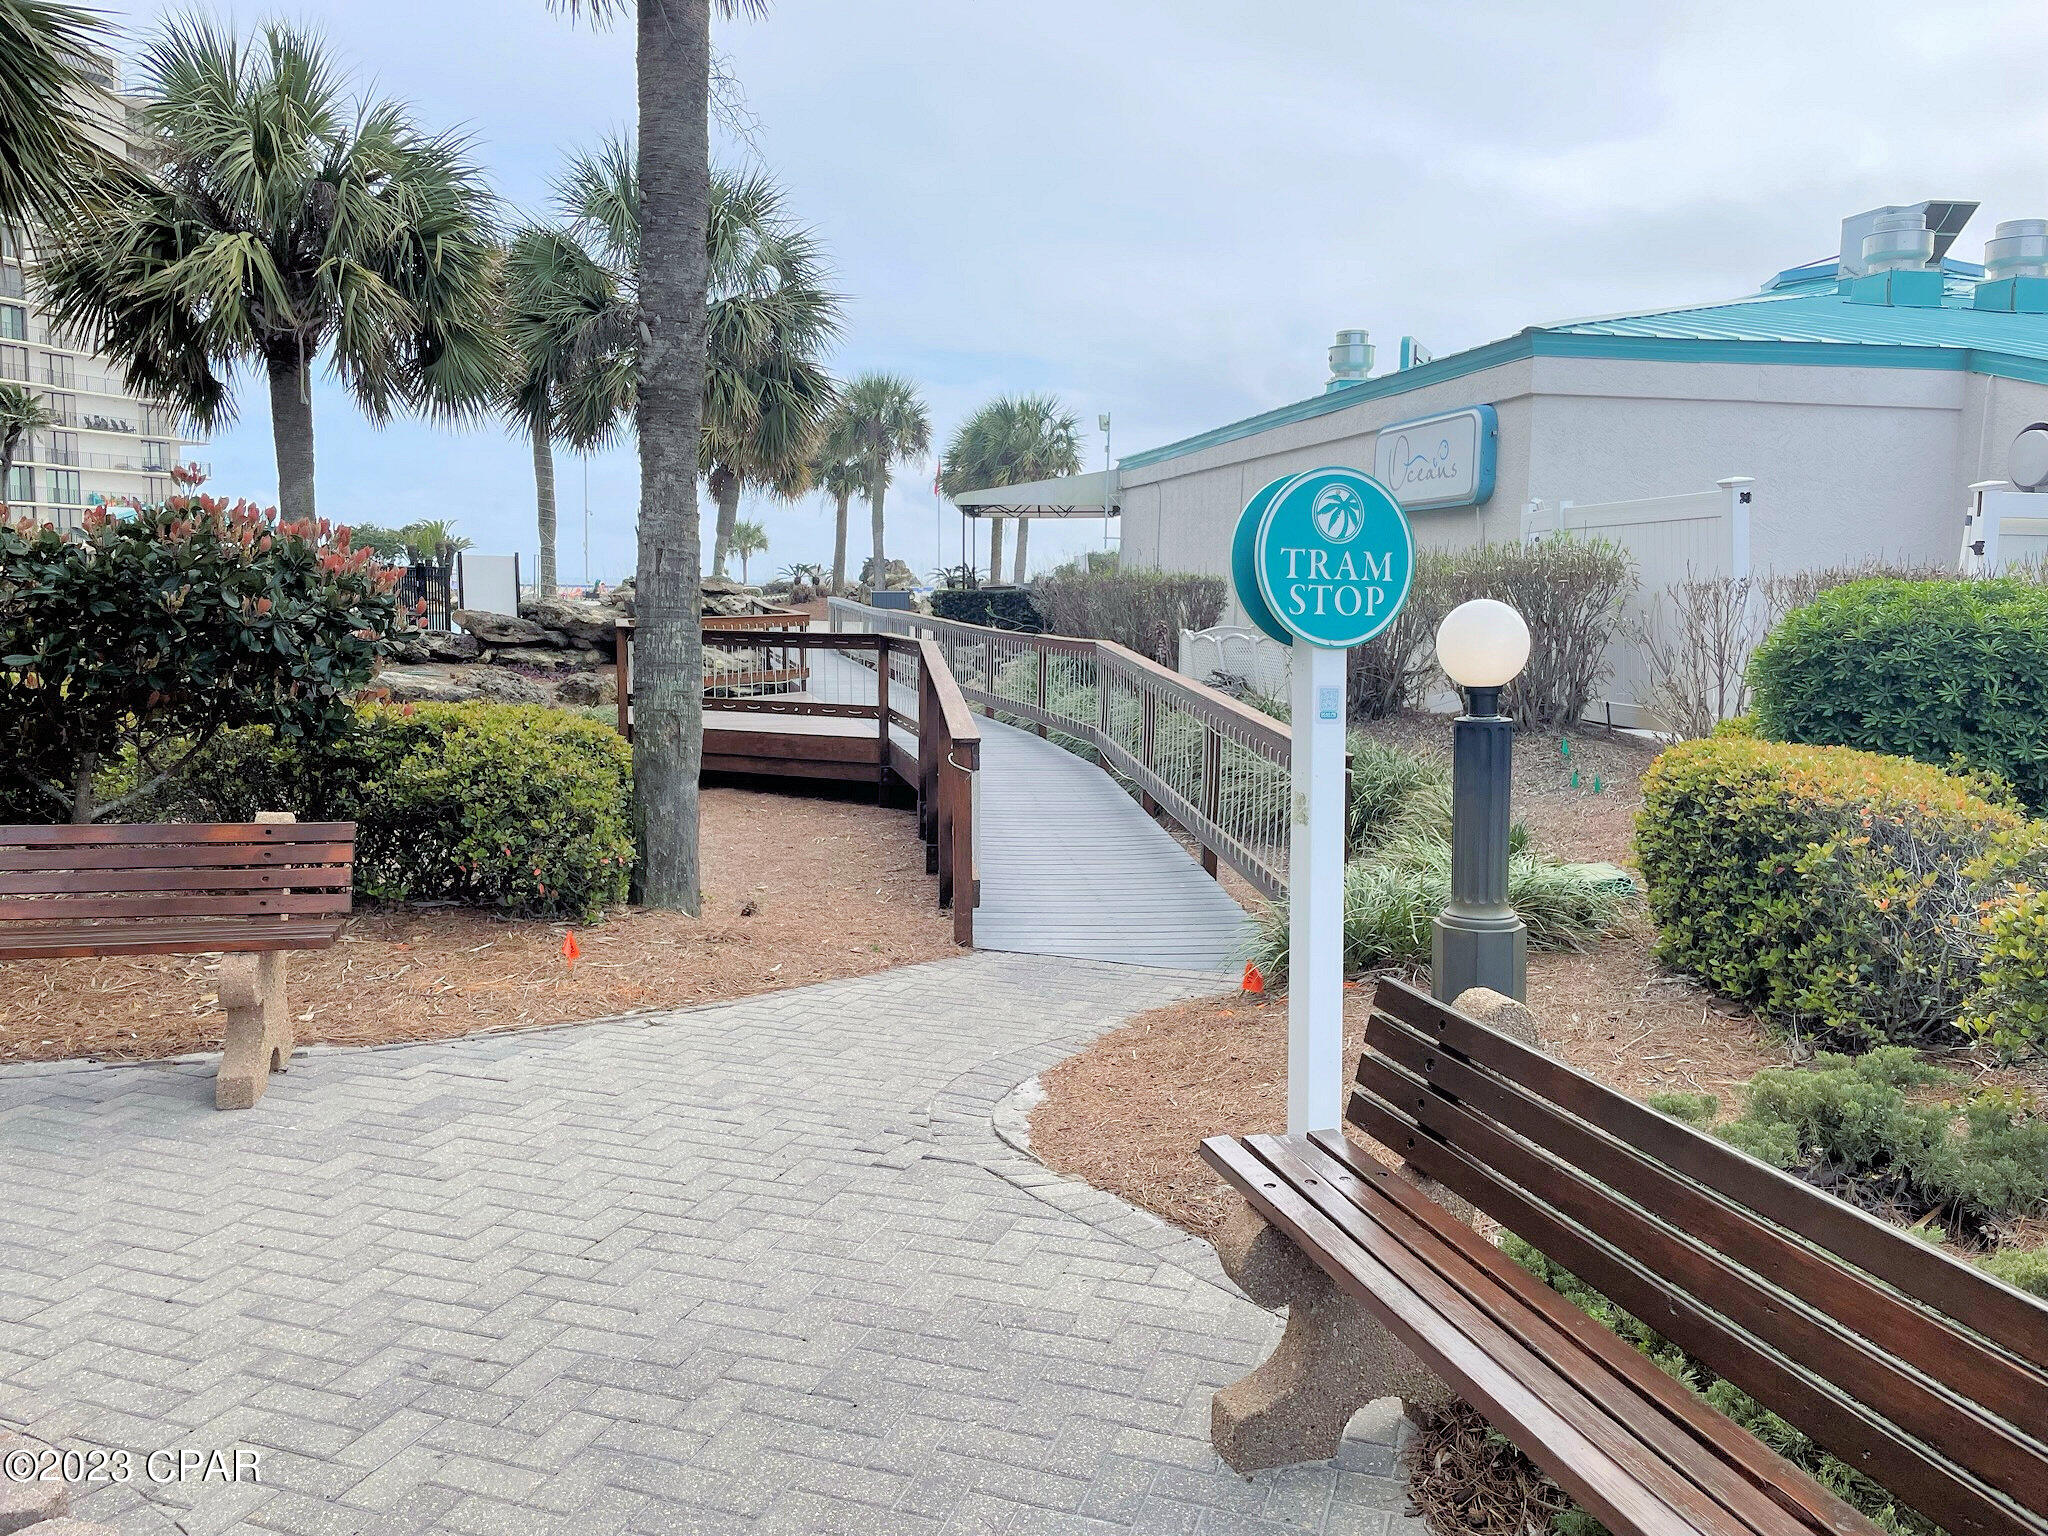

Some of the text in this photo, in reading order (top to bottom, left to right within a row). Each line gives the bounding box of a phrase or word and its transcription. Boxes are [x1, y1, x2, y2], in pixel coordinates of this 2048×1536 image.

[1388, 435, 1458, 491] Oceans
[1280, 547, 1393, 582] TRAM
[1288, 583, 1385, 617] STOP
